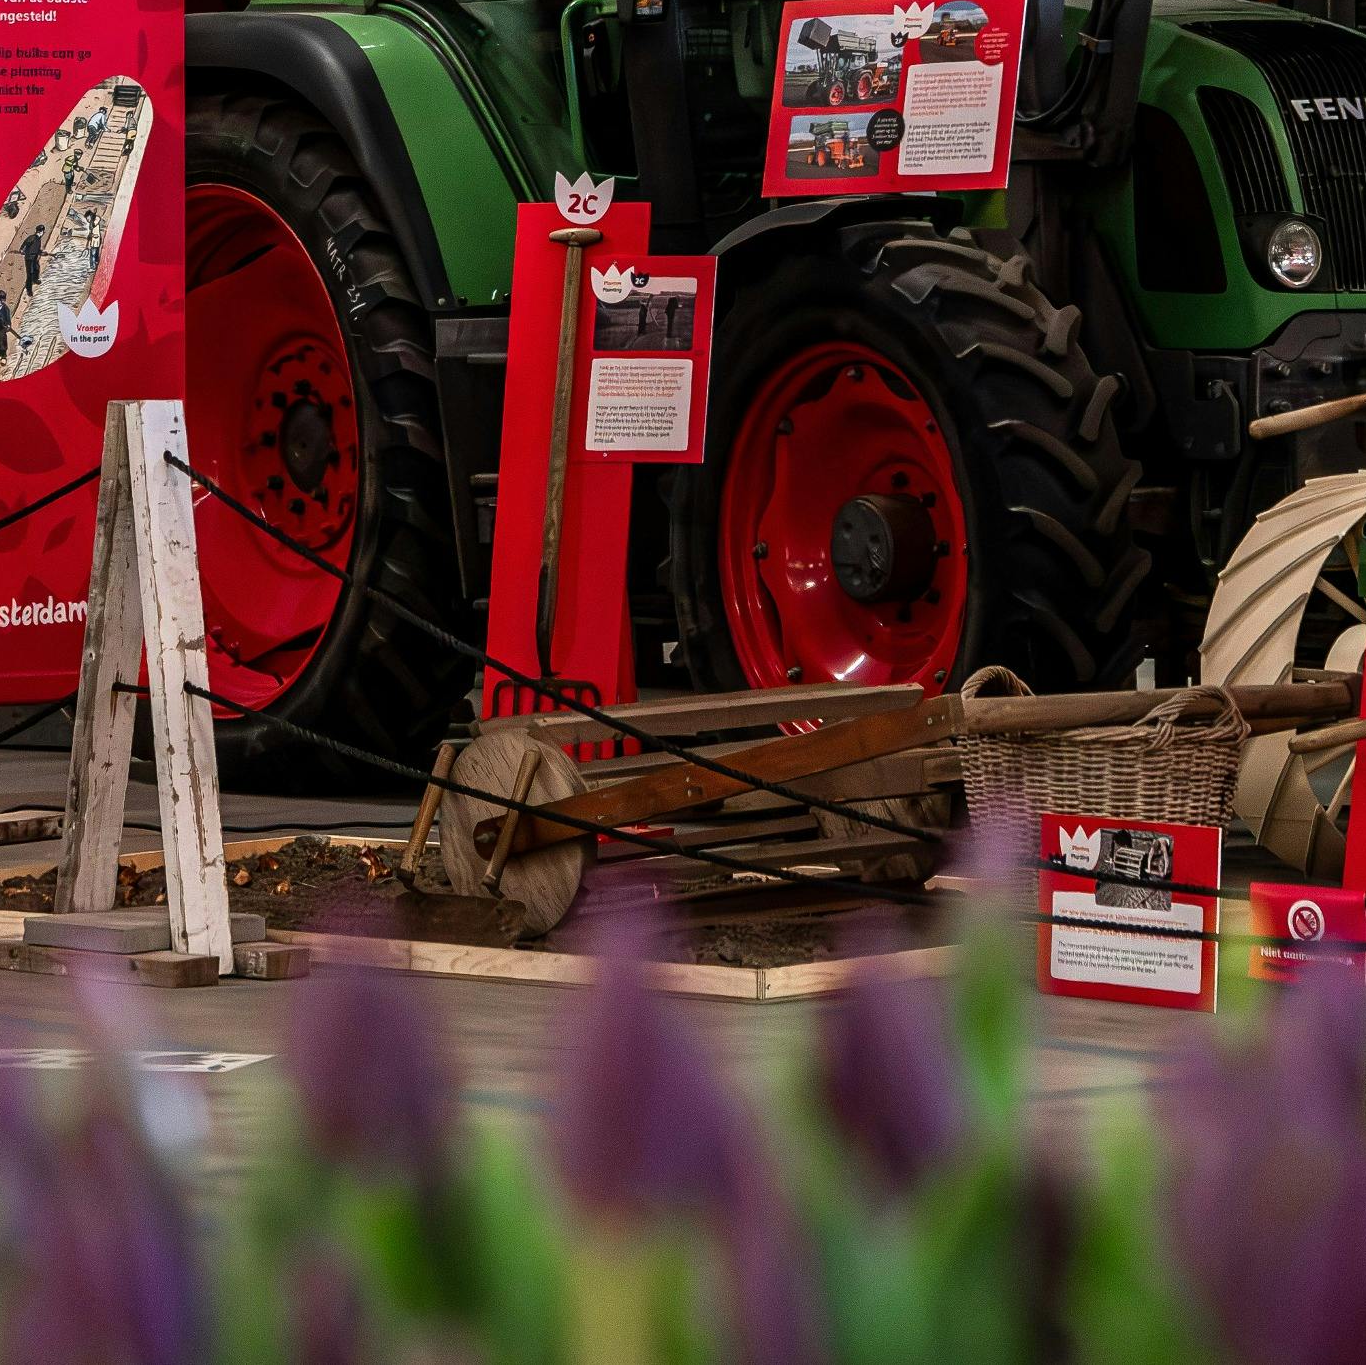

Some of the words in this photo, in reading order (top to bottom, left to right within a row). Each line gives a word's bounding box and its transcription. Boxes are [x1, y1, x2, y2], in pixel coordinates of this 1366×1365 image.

[568, 193, 598, 215] 2C
[79, 335, 92, 343] the
[92, 335, 110, 344] past
